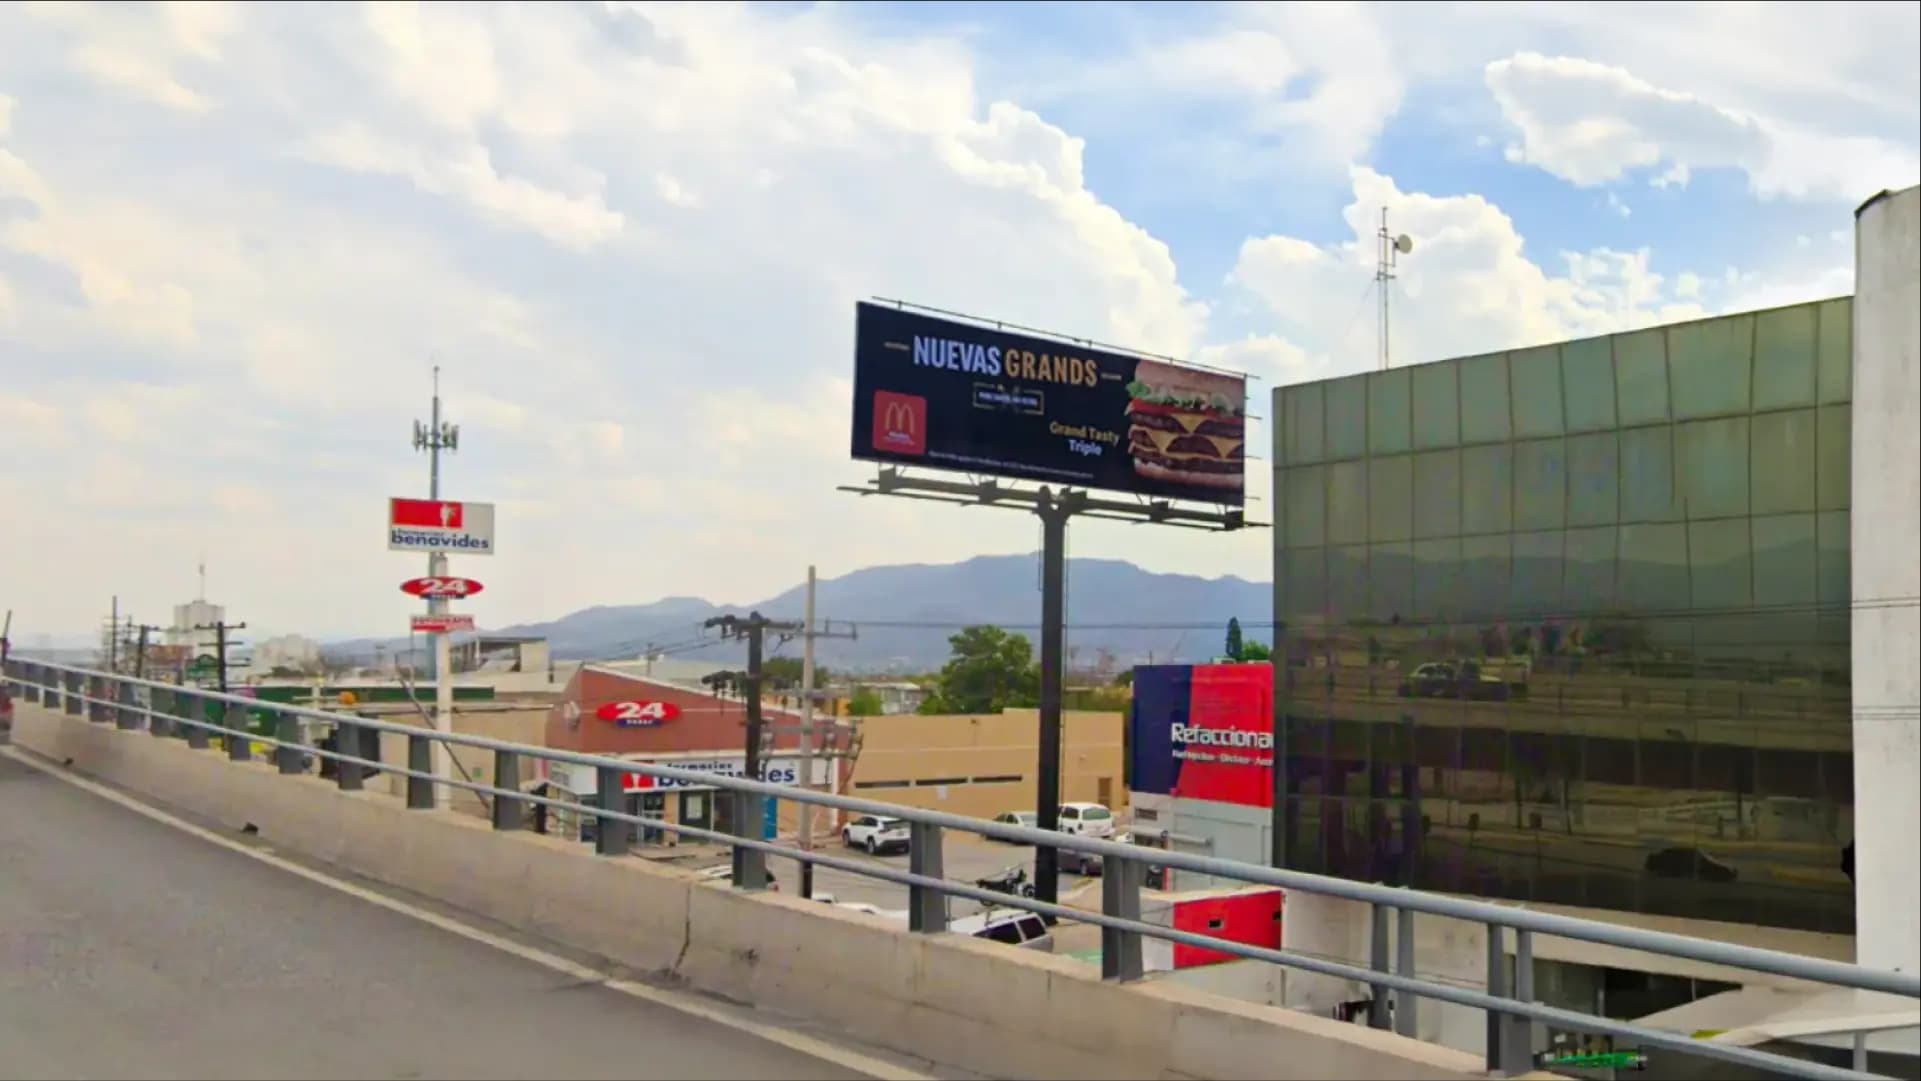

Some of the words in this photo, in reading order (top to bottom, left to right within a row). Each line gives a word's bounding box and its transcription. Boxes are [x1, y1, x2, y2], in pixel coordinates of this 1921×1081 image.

[914, 335, 1000, 376] NUEVAS
[1005, 348, 1098, 387] GRANDS
[1049, 420, 1087, 438] Grand
[1088, 426, 1120, 447] Tasty
[1068, 438, 1102, 456] Triple
[391, 529, 488, 548] benavides
[421, 579, 467, 594] 24
[616, 702, 665, 719] 24
